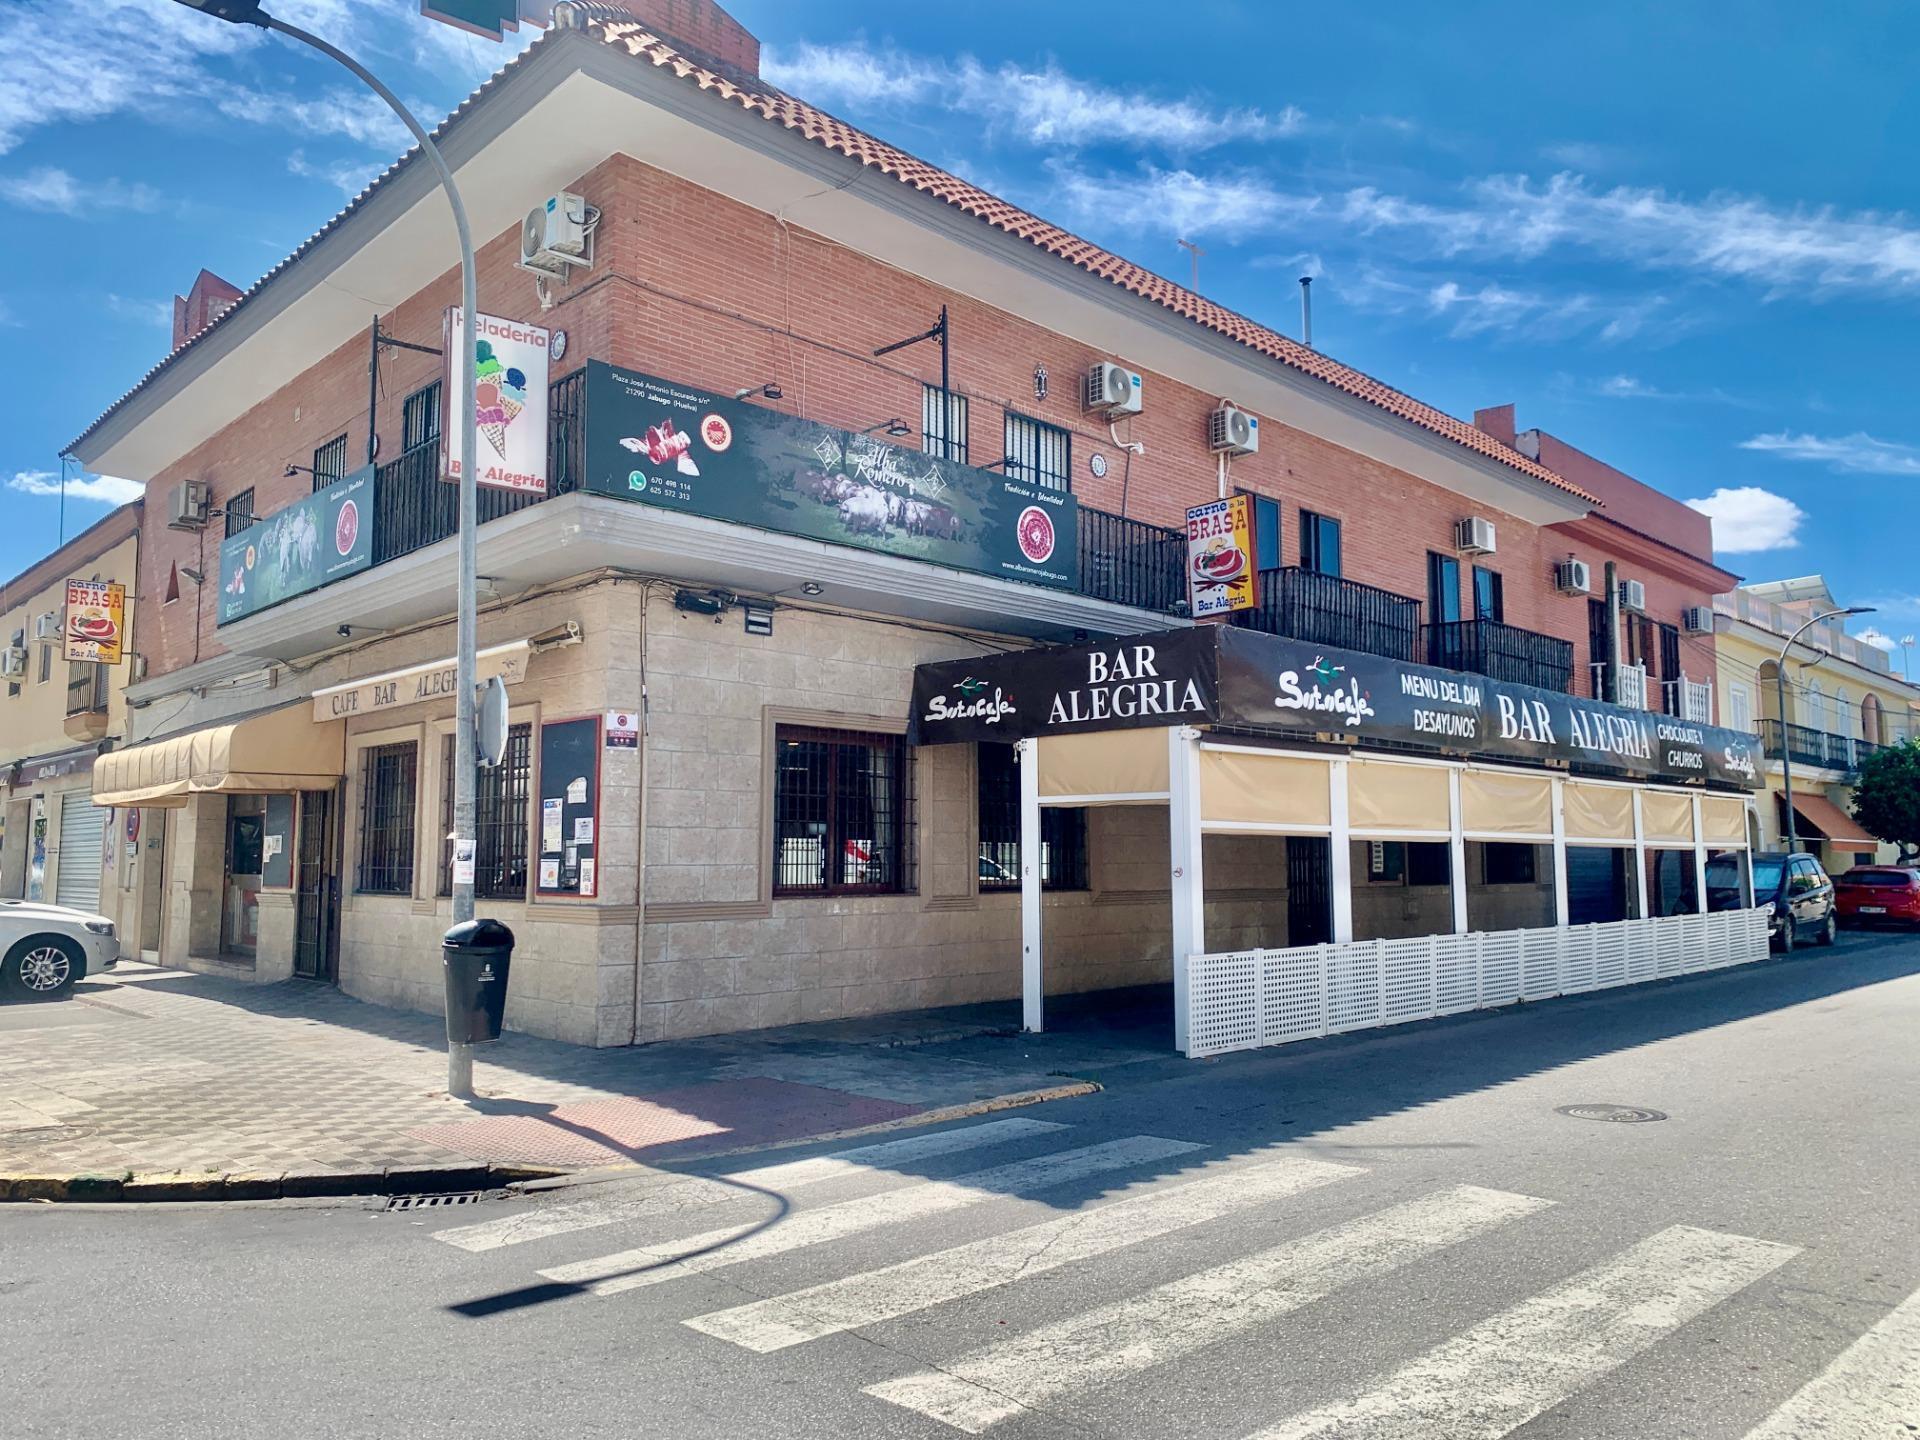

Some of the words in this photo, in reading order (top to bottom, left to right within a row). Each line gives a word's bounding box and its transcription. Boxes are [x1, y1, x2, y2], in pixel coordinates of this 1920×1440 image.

[612, 373, 629, 384] Plaza
[630, 377, 644, 388] José
[645, 382, 669, 395] Antonio
[625, 387, 645, 398] 21290
[647, 393, 671, 406] Jabugo
[673, 400, 698, 412] (Huelva)
[862, 443, 898, 472] Alba
[854, 455, 909, 488] Romero
[651, 476, 662, 485] 670
[680, 482, 691, 491] 114
[664, 489, 676, 498] 572
[678, 491, 690, 501] 313
[1188, 501, 1228, 519] carne
[1188, 508, 1247, 542] BRASA
[69, 580, 107, 591] carne
[69, 588, 121, 608] BRASA
[1198, 600, 1213, 611] Bar
[70, 648, 84, 658] Bar
[1087, 645, 1160, 684] BAR
[332, 690, 359, 716] CAFE
[374, 682, 397, 706] BAR
[1047, 677, 1206, 724] ALEGRIA
[1401, 673, 1438, 700] MENU
[1439, 680, 1463, 704] DEL
[1463, 685, 1481, 708] DIA
[1413, 708, 1475, 739] DESAYUNOS
[1496, 693, 1556, 745] BAR
[1569, 707, 1651, 760] ALEGRIA
[1657, 724, 1697, 744] CHOCOLATE
[1667, 750, 1703, 769] CHURROS
